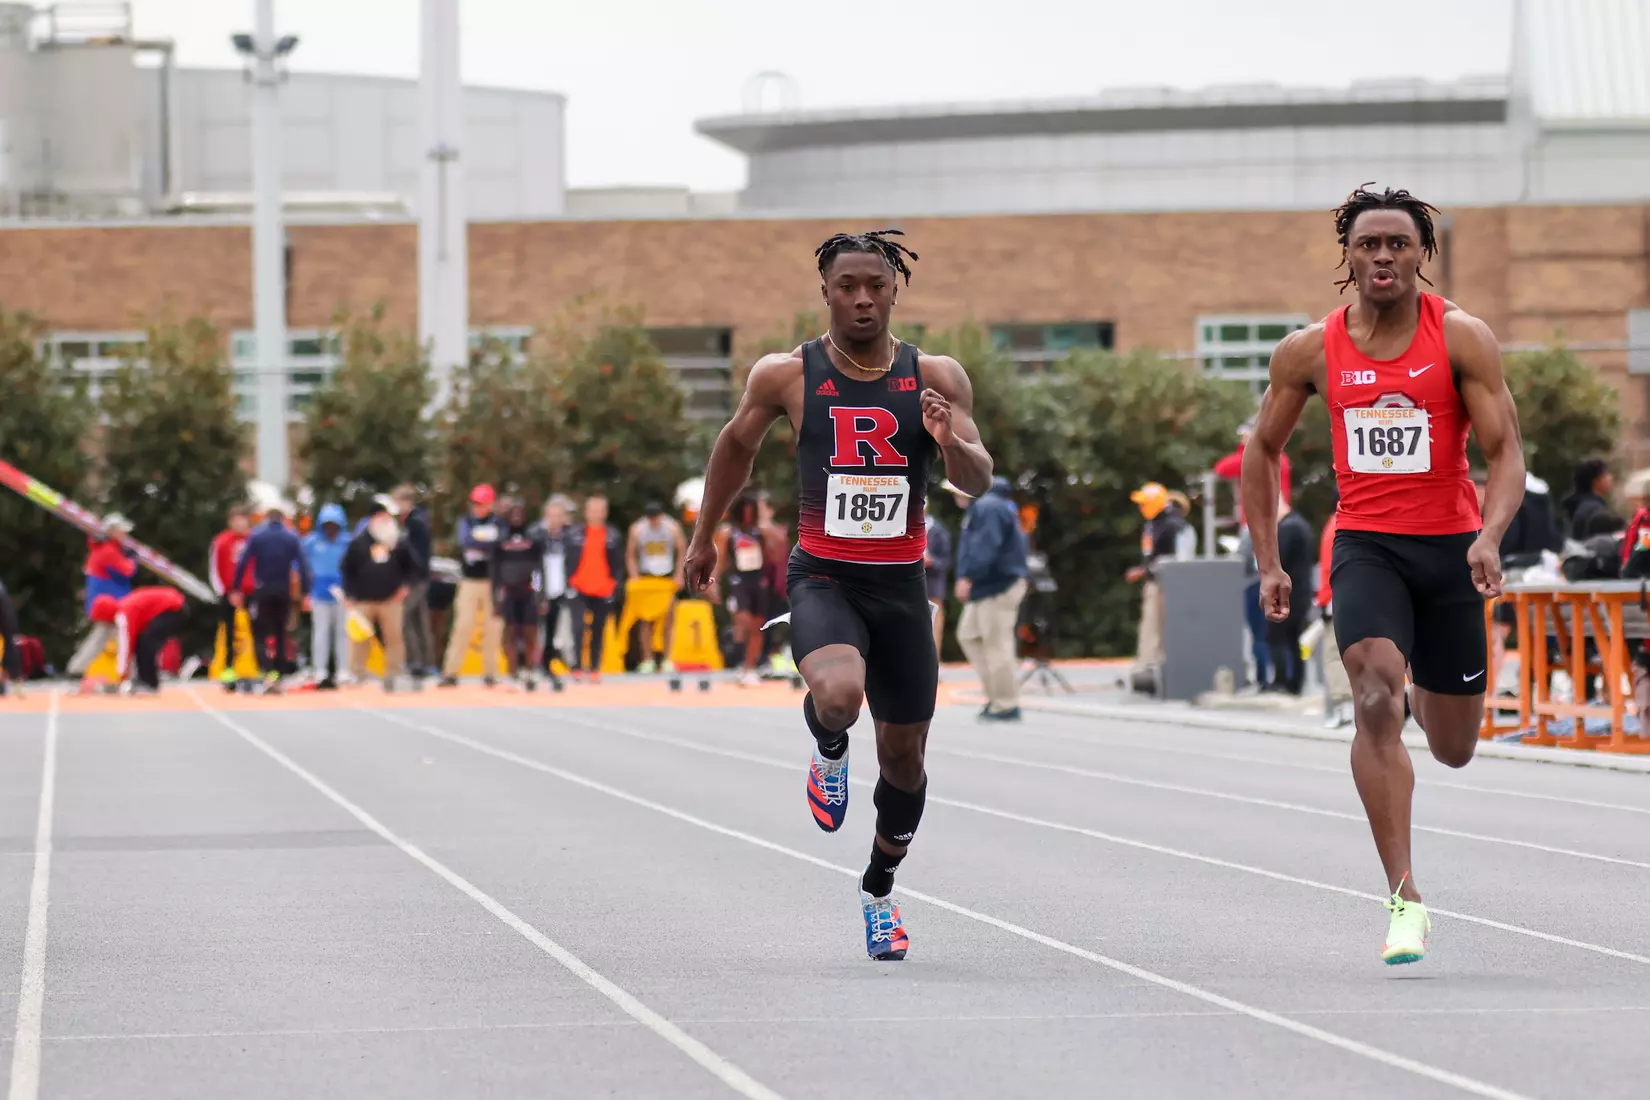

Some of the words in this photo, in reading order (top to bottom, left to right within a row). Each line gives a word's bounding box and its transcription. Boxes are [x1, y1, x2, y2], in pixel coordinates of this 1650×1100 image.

[1354, 409, 1416, 419] TENNESSEE
[829, 406, 908, 467] R
[1354, 427, 1422, 456] 1687
[840, 476, 900, 486] TENNESSEE
[835, 493, 903, 522] 1857
